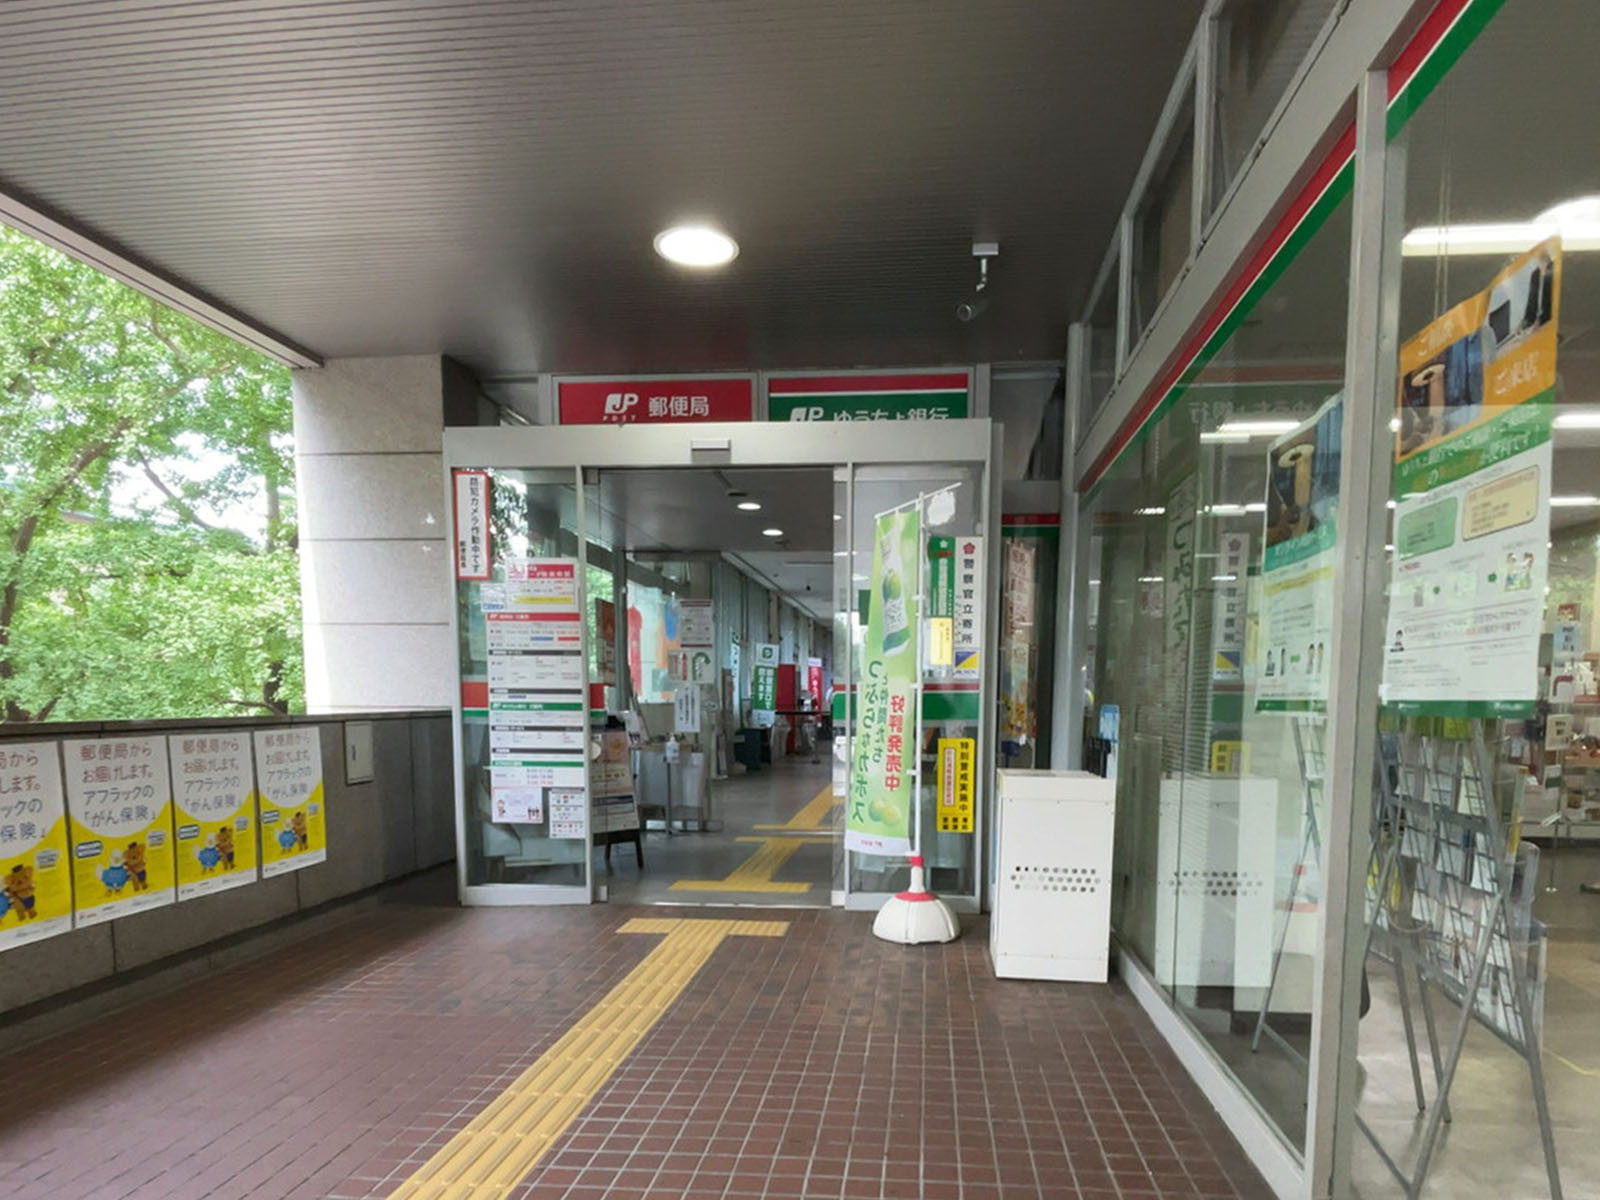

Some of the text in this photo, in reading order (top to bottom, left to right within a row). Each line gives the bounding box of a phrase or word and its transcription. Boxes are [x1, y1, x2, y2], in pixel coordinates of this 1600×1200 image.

[648, 396, 709, 417] 郵便局
[962, 559, 975, 643] 警察官立寄所
[81, 741, 152, 761] 郵便局から
[183, 737, 239, 754] 郵便局から
[83, 764, 153, 783] お届けします。
[960, 742, 969, 811] 特別警戒実施中
[184, 776, 240, 793] アフラックの
[83, 785, 154, 806] アフラックの
[84, 805, 156, 828] 「がん保険」
